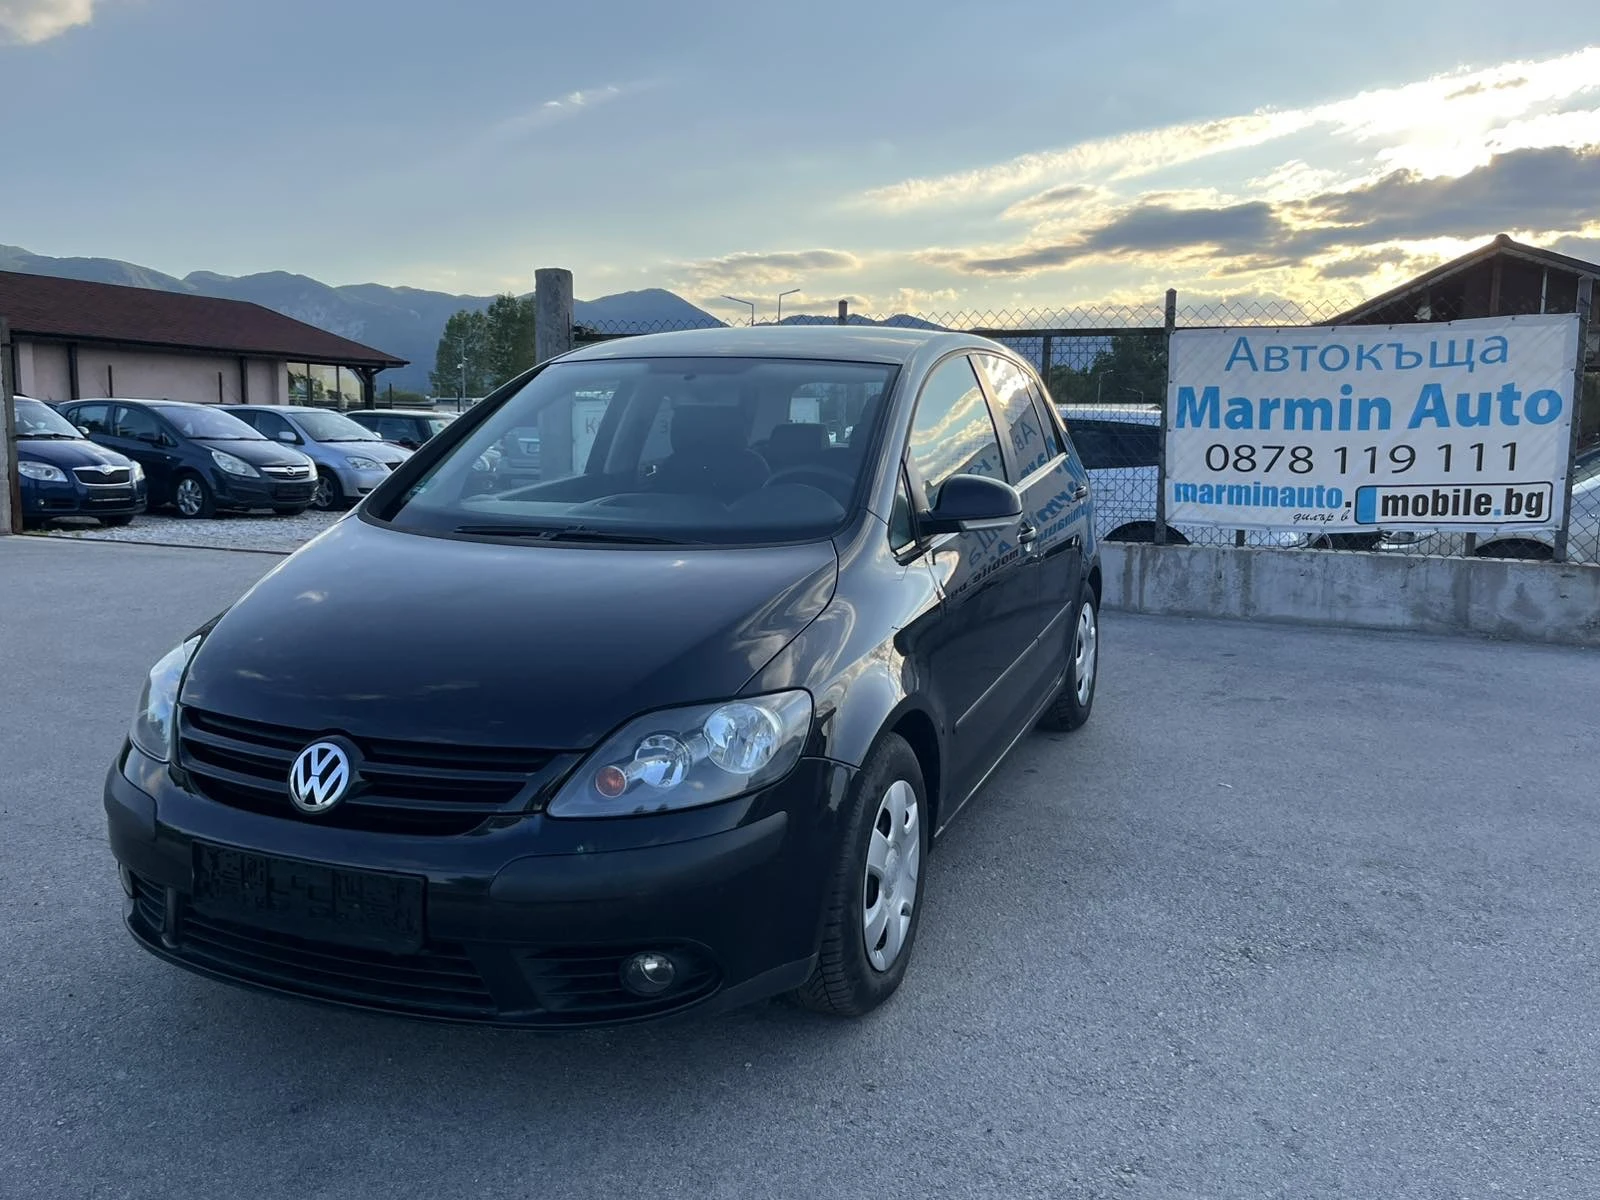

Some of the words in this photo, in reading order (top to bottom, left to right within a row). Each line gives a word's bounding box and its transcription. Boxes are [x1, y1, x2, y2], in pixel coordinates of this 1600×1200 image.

[1224, 335, 1509, 373] Автокъща
[1175, 383, 1392, 431] Marmin
[1407, 381, 1563, 428] Auto
[1205, 443, 1315, 475] 0878
[1333, 445, 1417, 475] 119
[1437, 441, 1518, 473] 111
[1380, 488, 1545, 517] mobile.bg
